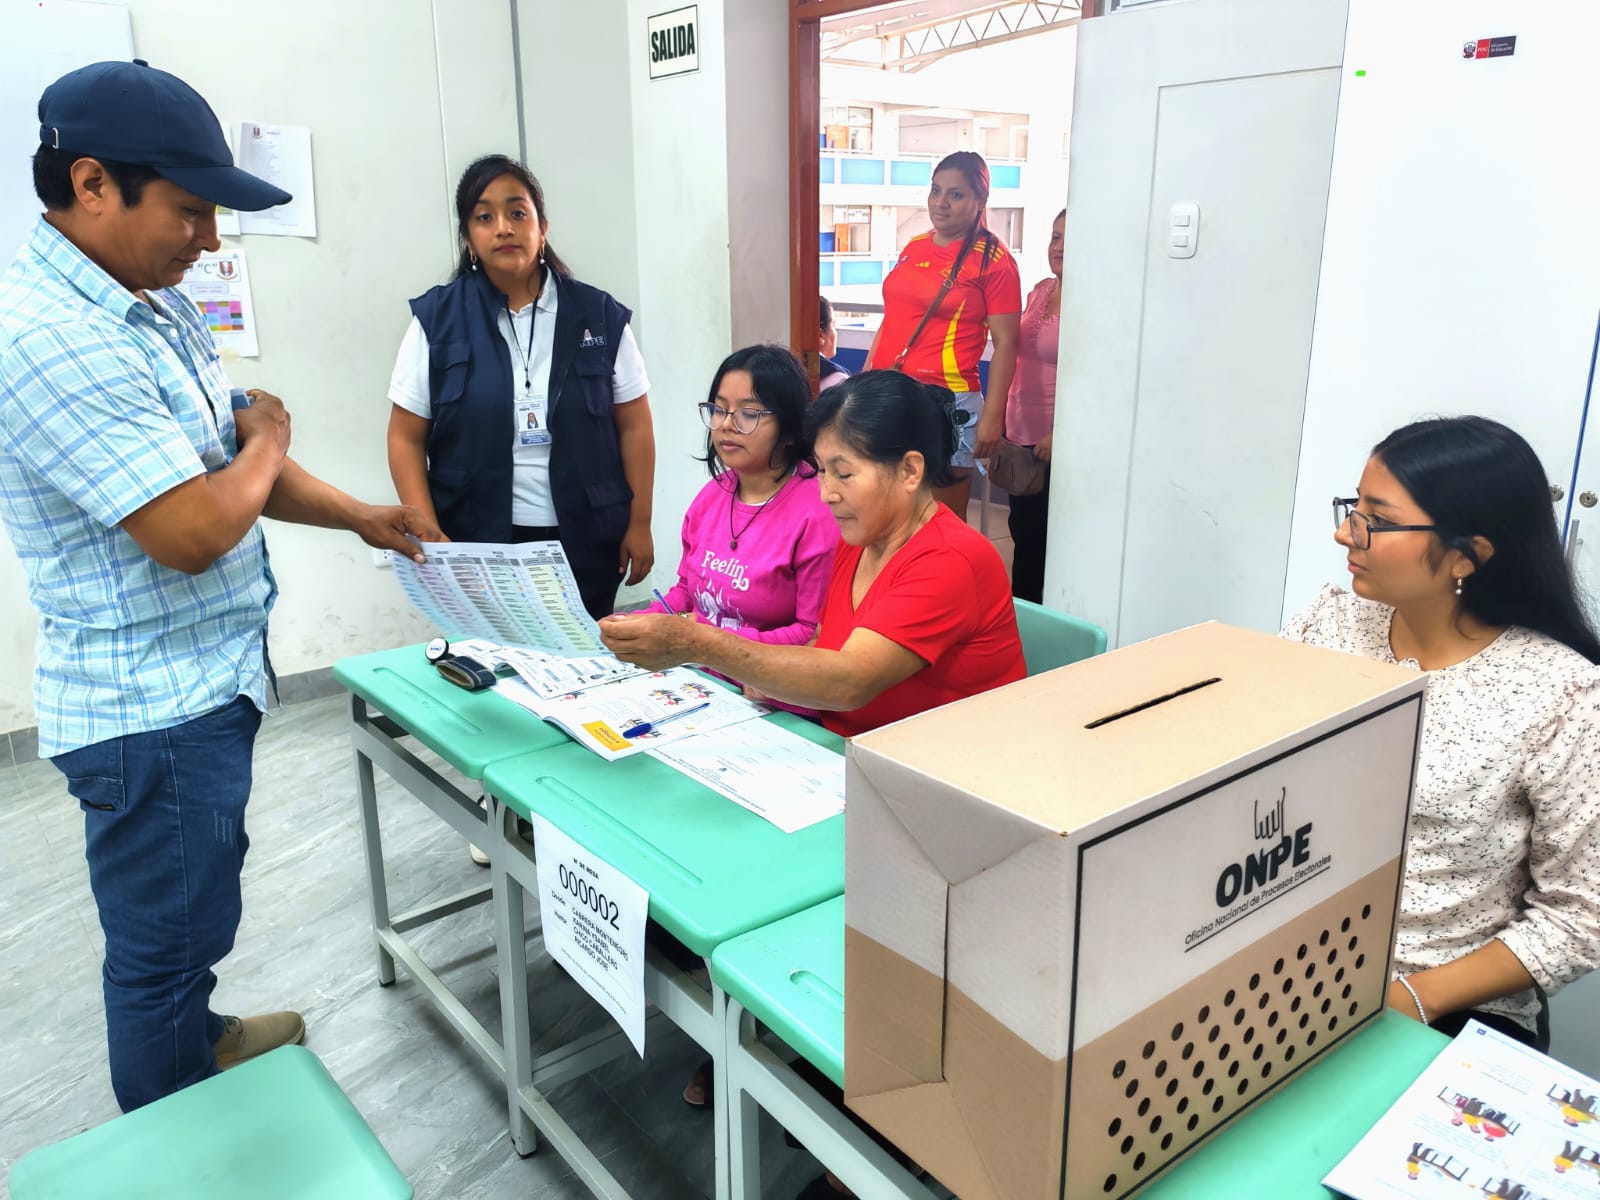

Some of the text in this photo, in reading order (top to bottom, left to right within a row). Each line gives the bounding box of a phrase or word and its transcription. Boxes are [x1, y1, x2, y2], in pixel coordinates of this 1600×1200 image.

[651, 22, 696, 63] SALIDA
[559, 863, 620, 931] 000002
[586, 866, 599, 879] MESA
[1216, 822, 1312, 908] ONPE
[1184, 854, 1332, 945] Oficina Nacional de Procesos Electorales
